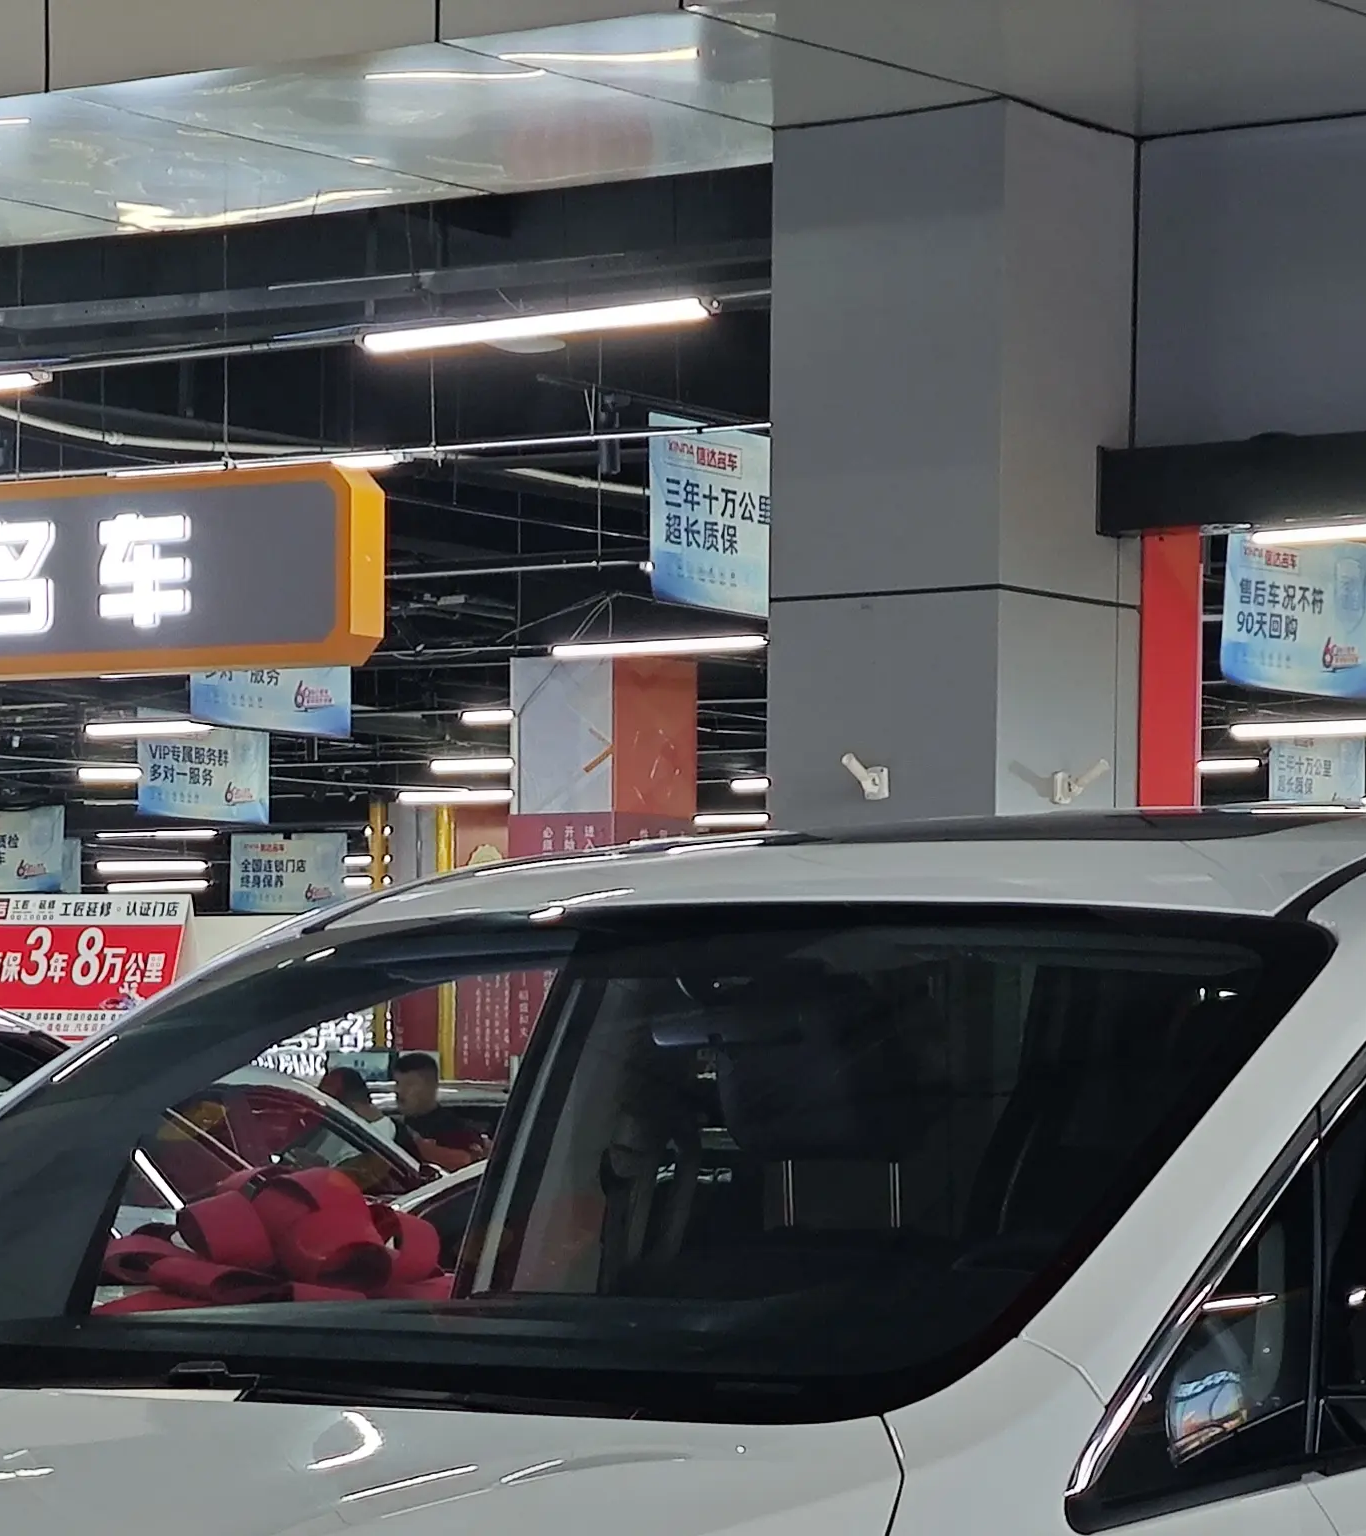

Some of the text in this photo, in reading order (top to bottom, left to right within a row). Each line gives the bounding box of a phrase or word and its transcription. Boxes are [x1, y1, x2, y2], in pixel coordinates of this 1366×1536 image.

[696, 446, 738, 471] 信达名车
[665, 477, 770, 525] 三年十万公里
[665, 512, 738, 555] 超长质保
[1239, 578, 1325, 615] 售后车况不符
[1237, 611, 1299, 642] 90天回购
[149, 744, 229, 767] VIP专属服务群
[149, 764, 213, 787] 多对一服务
[241, 858, 308, 873] 全国连锁门店
